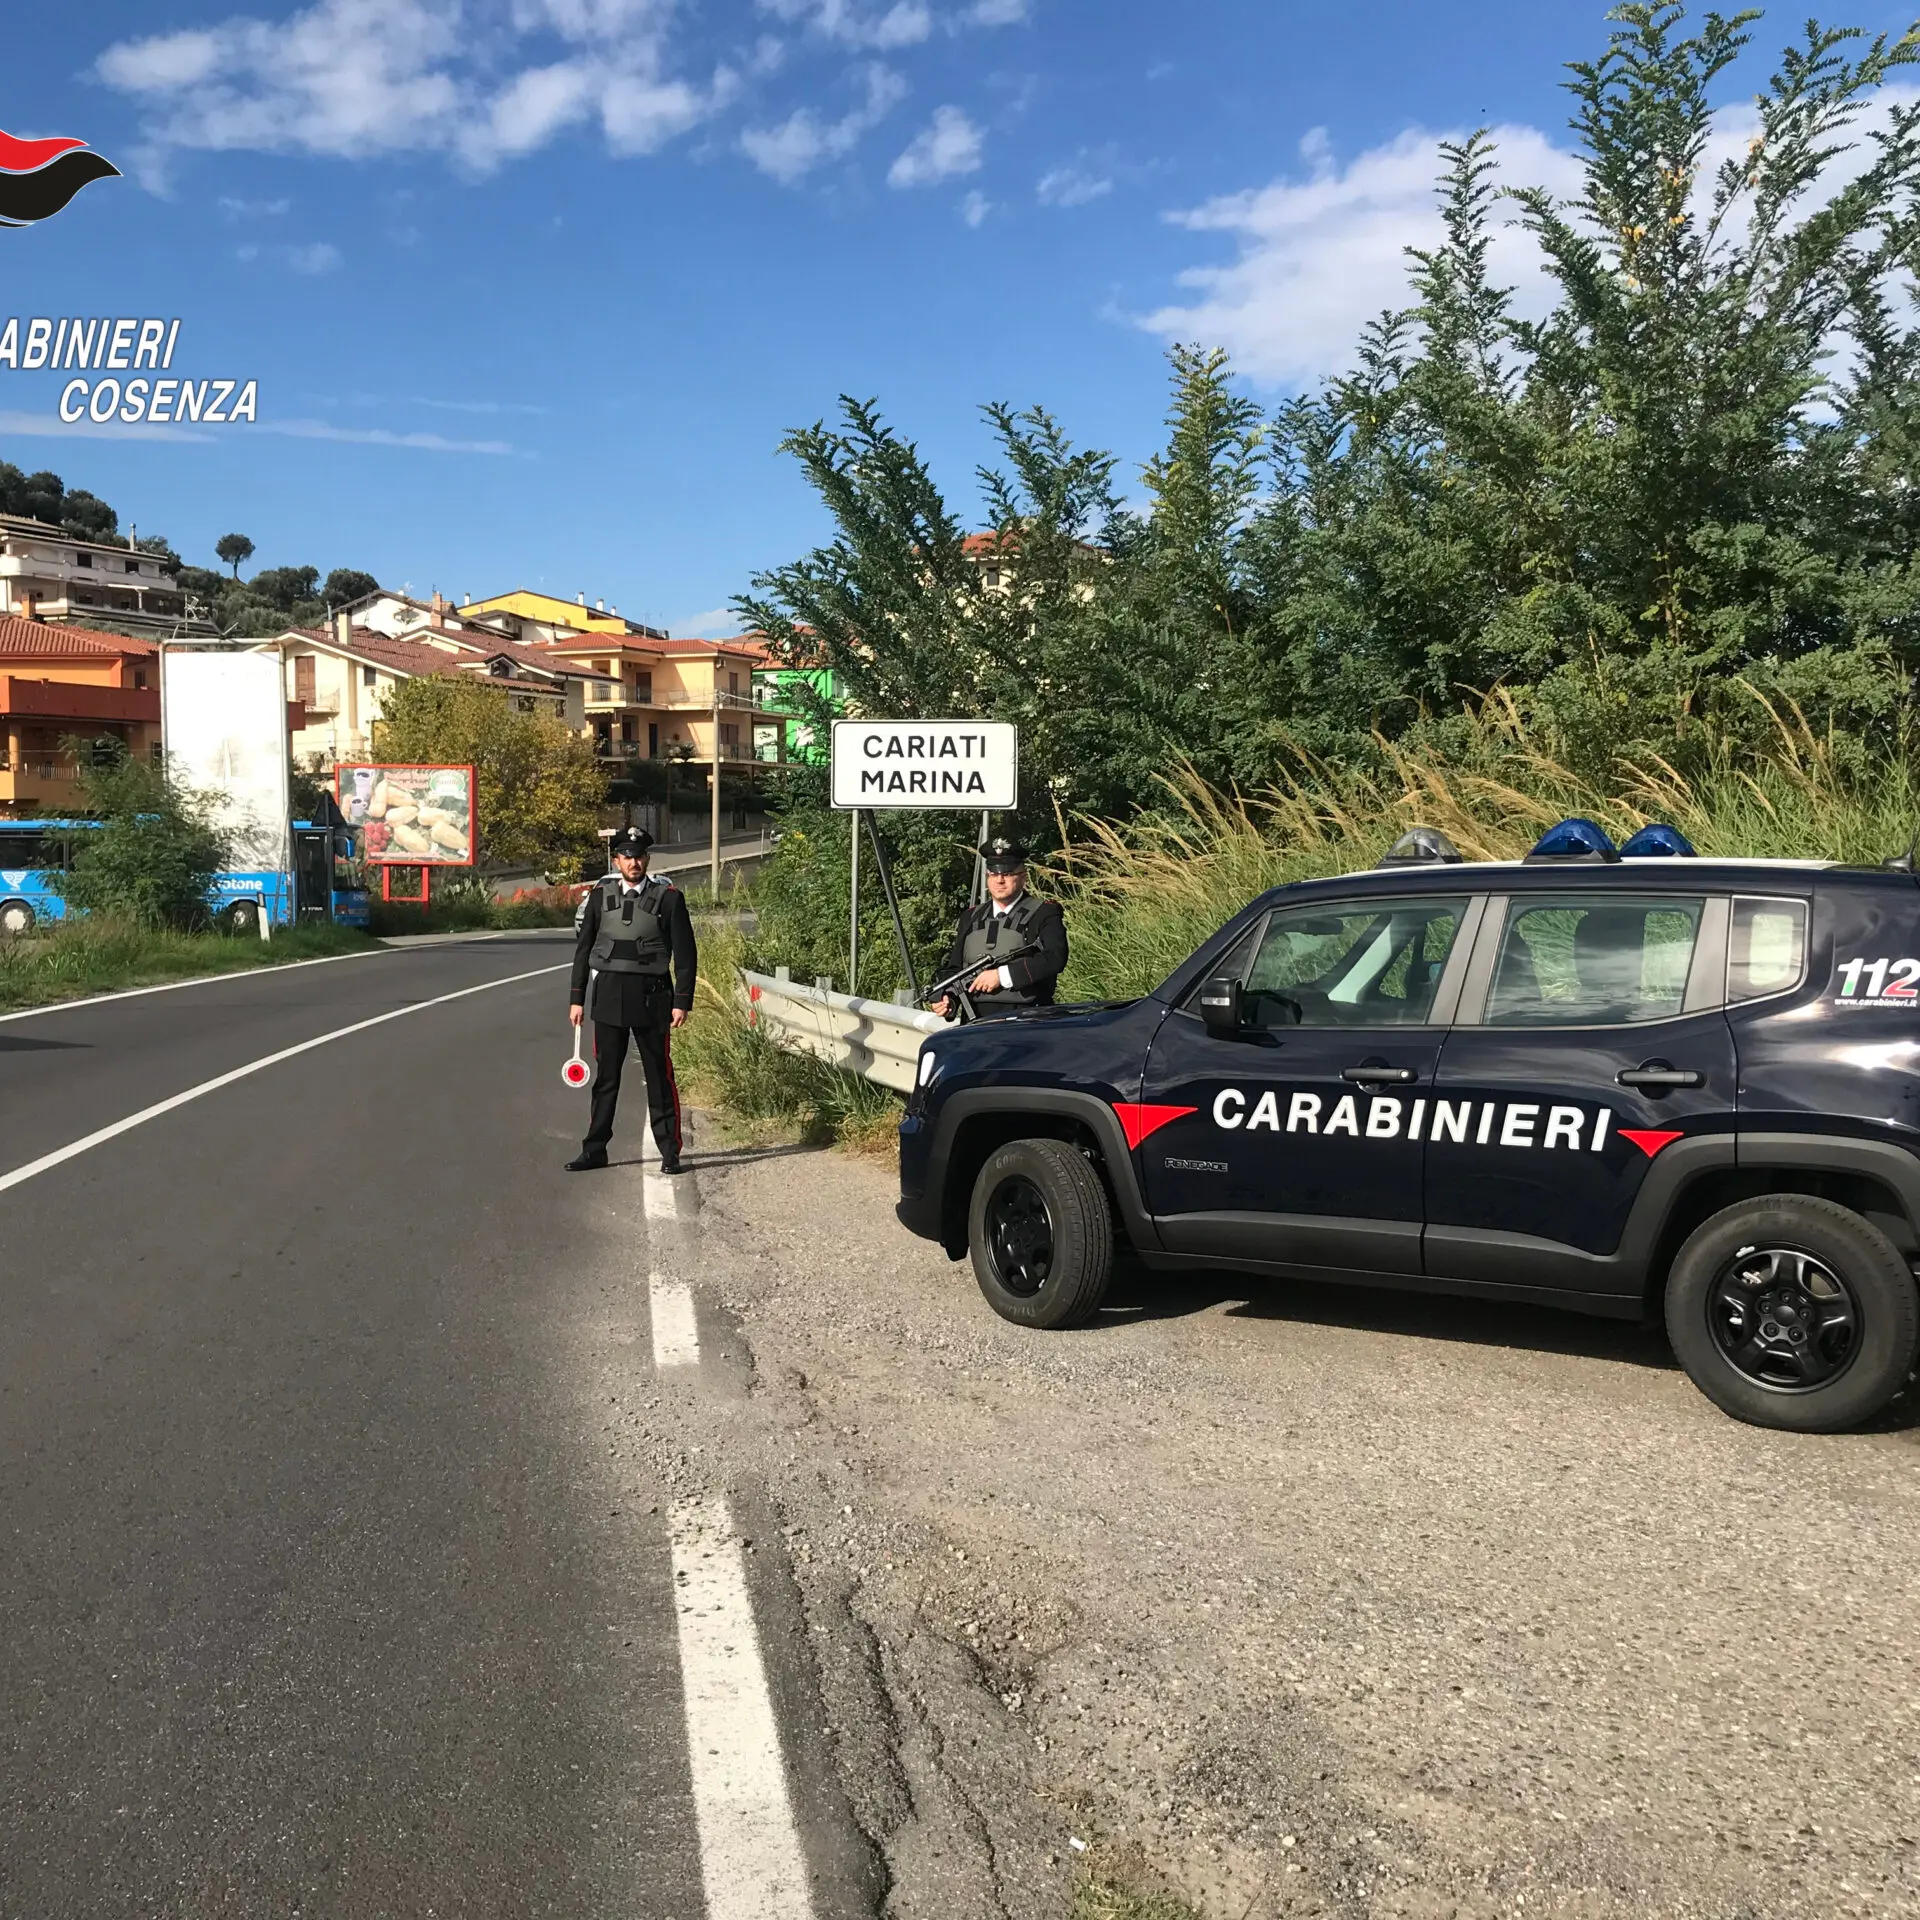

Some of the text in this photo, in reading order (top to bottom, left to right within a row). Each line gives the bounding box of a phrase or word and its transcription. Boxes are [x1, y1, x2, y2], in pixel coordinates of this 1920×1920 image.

[863, 734, 986, 759] CARIATI
[861, 770, 986, 794] MARINA
[1837, 957, 1920, 998] 112
[1834, 998, 1918, 1008] www.carabinieri.it
[1212, 1088, 1612, 1152] CARABINIERI
[1164, 1157, 1229, 1173] RENEGADE
